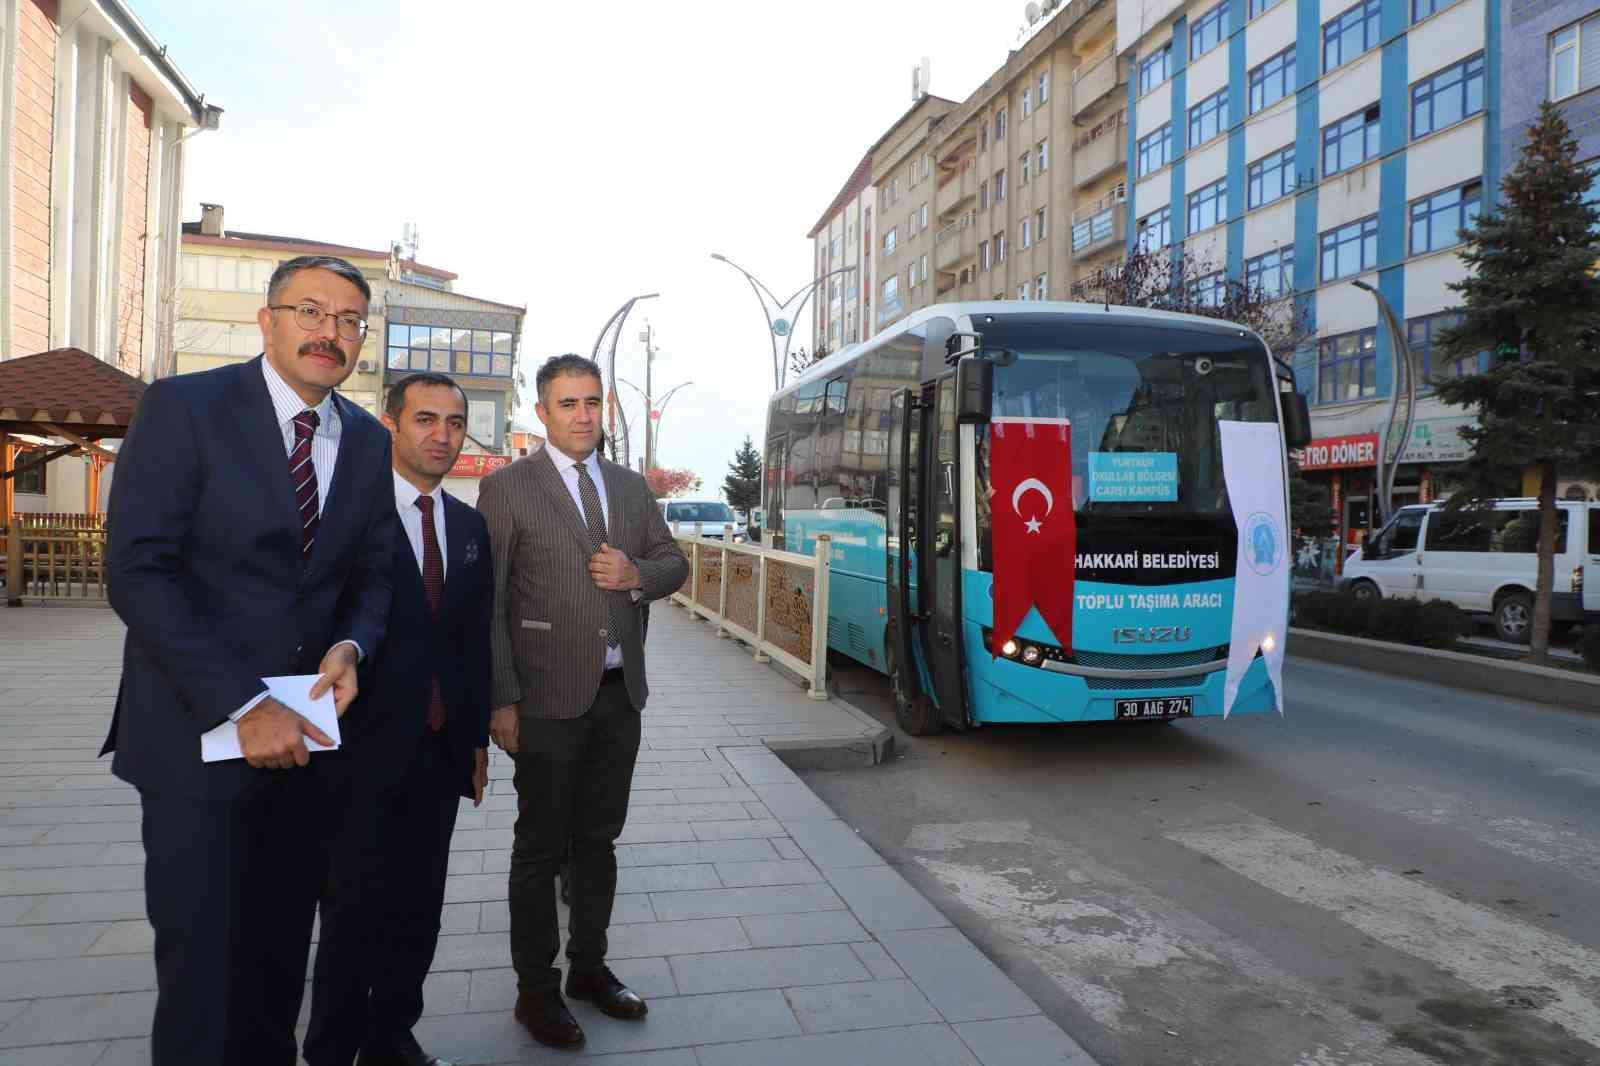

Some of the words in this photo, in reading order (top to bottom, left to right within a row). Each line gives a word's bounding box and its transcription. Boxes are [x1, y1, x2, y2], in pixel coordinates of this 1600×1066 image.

[1297, 446, 1328, 466] ETRO
[1331, 440, 1374, 464] DÖNER
[1074, 550, 1138, 569] HAKKARİ
[1143, 551, 1219, 569] BELEDİYESİ
[1077, 594, 1123, 610] TOPLU
[1128, 594, 1180, 612] TAŞIMA
[1183, 593, 1222, 608] ARACI
[1113, 625, 1191, 644] ISUZU
[1123, 703, 1138, 717] 30
[1143, 701, 1164, 715] AAG
[1169, 699, 1188, 714] 274
